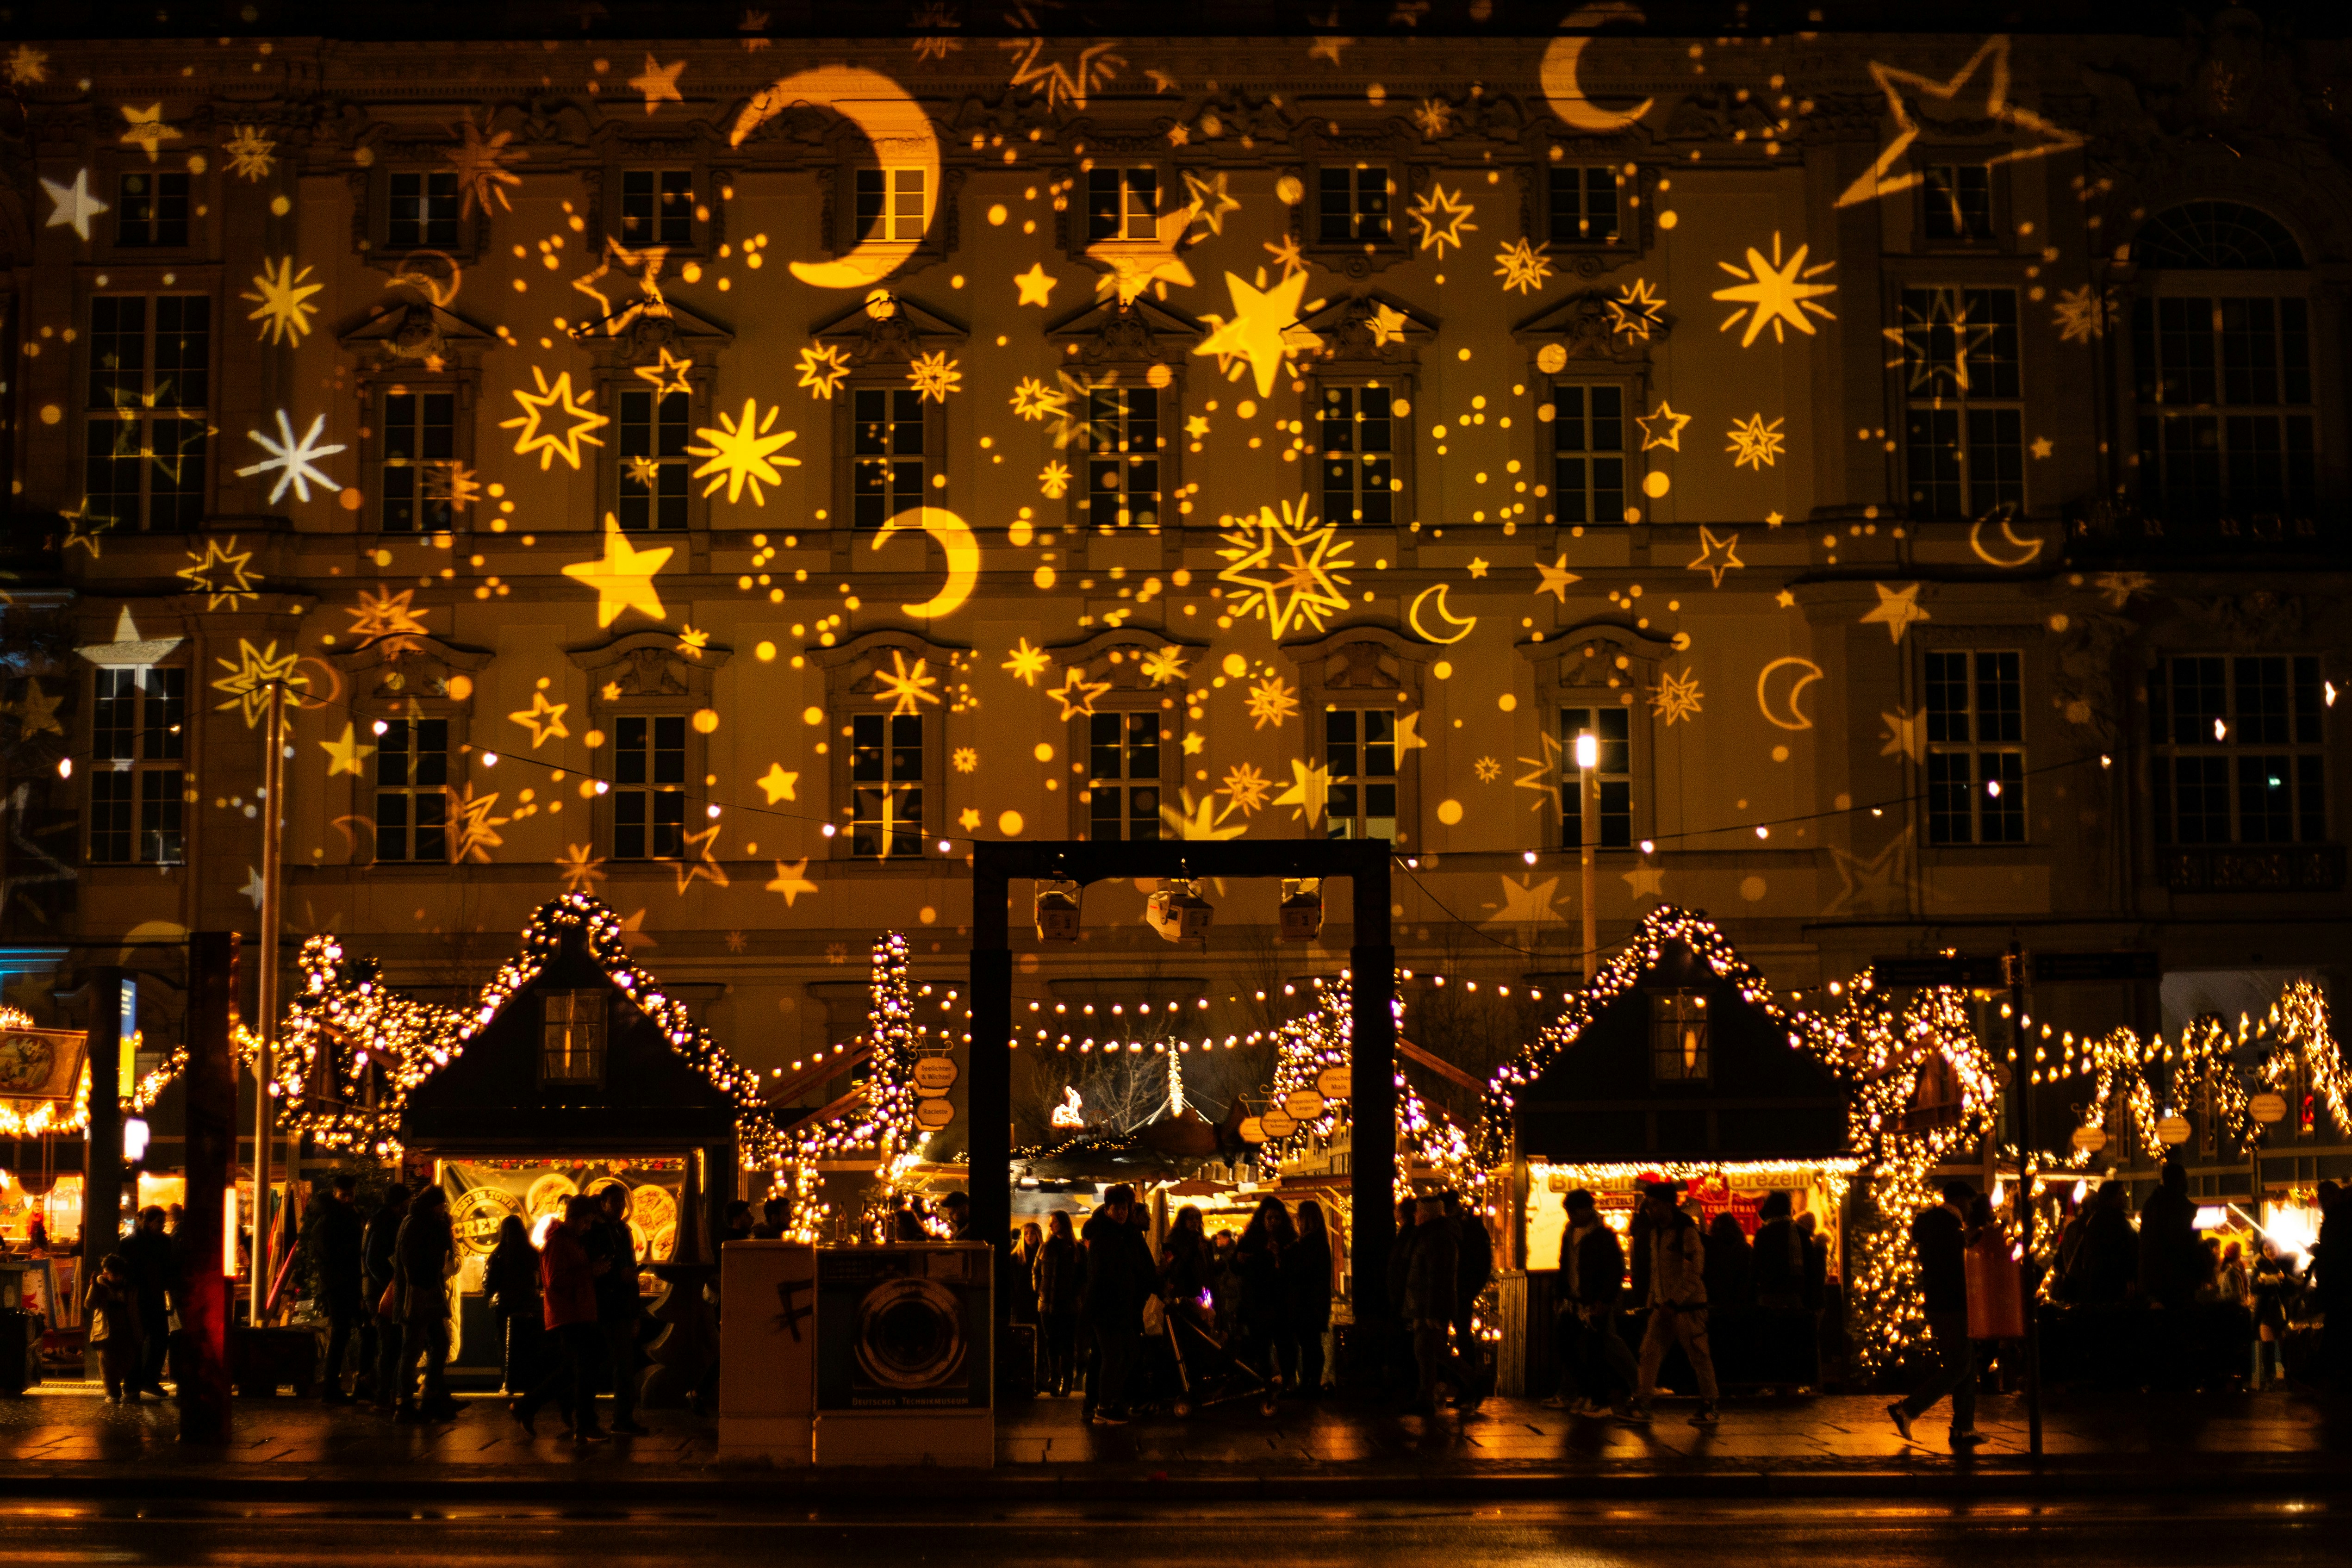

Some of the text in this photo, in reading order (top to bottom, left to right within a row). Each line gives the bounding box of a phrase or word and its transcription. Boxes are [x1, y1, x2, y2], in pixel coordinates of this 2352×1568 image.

[1731, 1171, 1811, 1187] Brezeln
[454, 1191, 516, 1218] BEST IN TOWN
